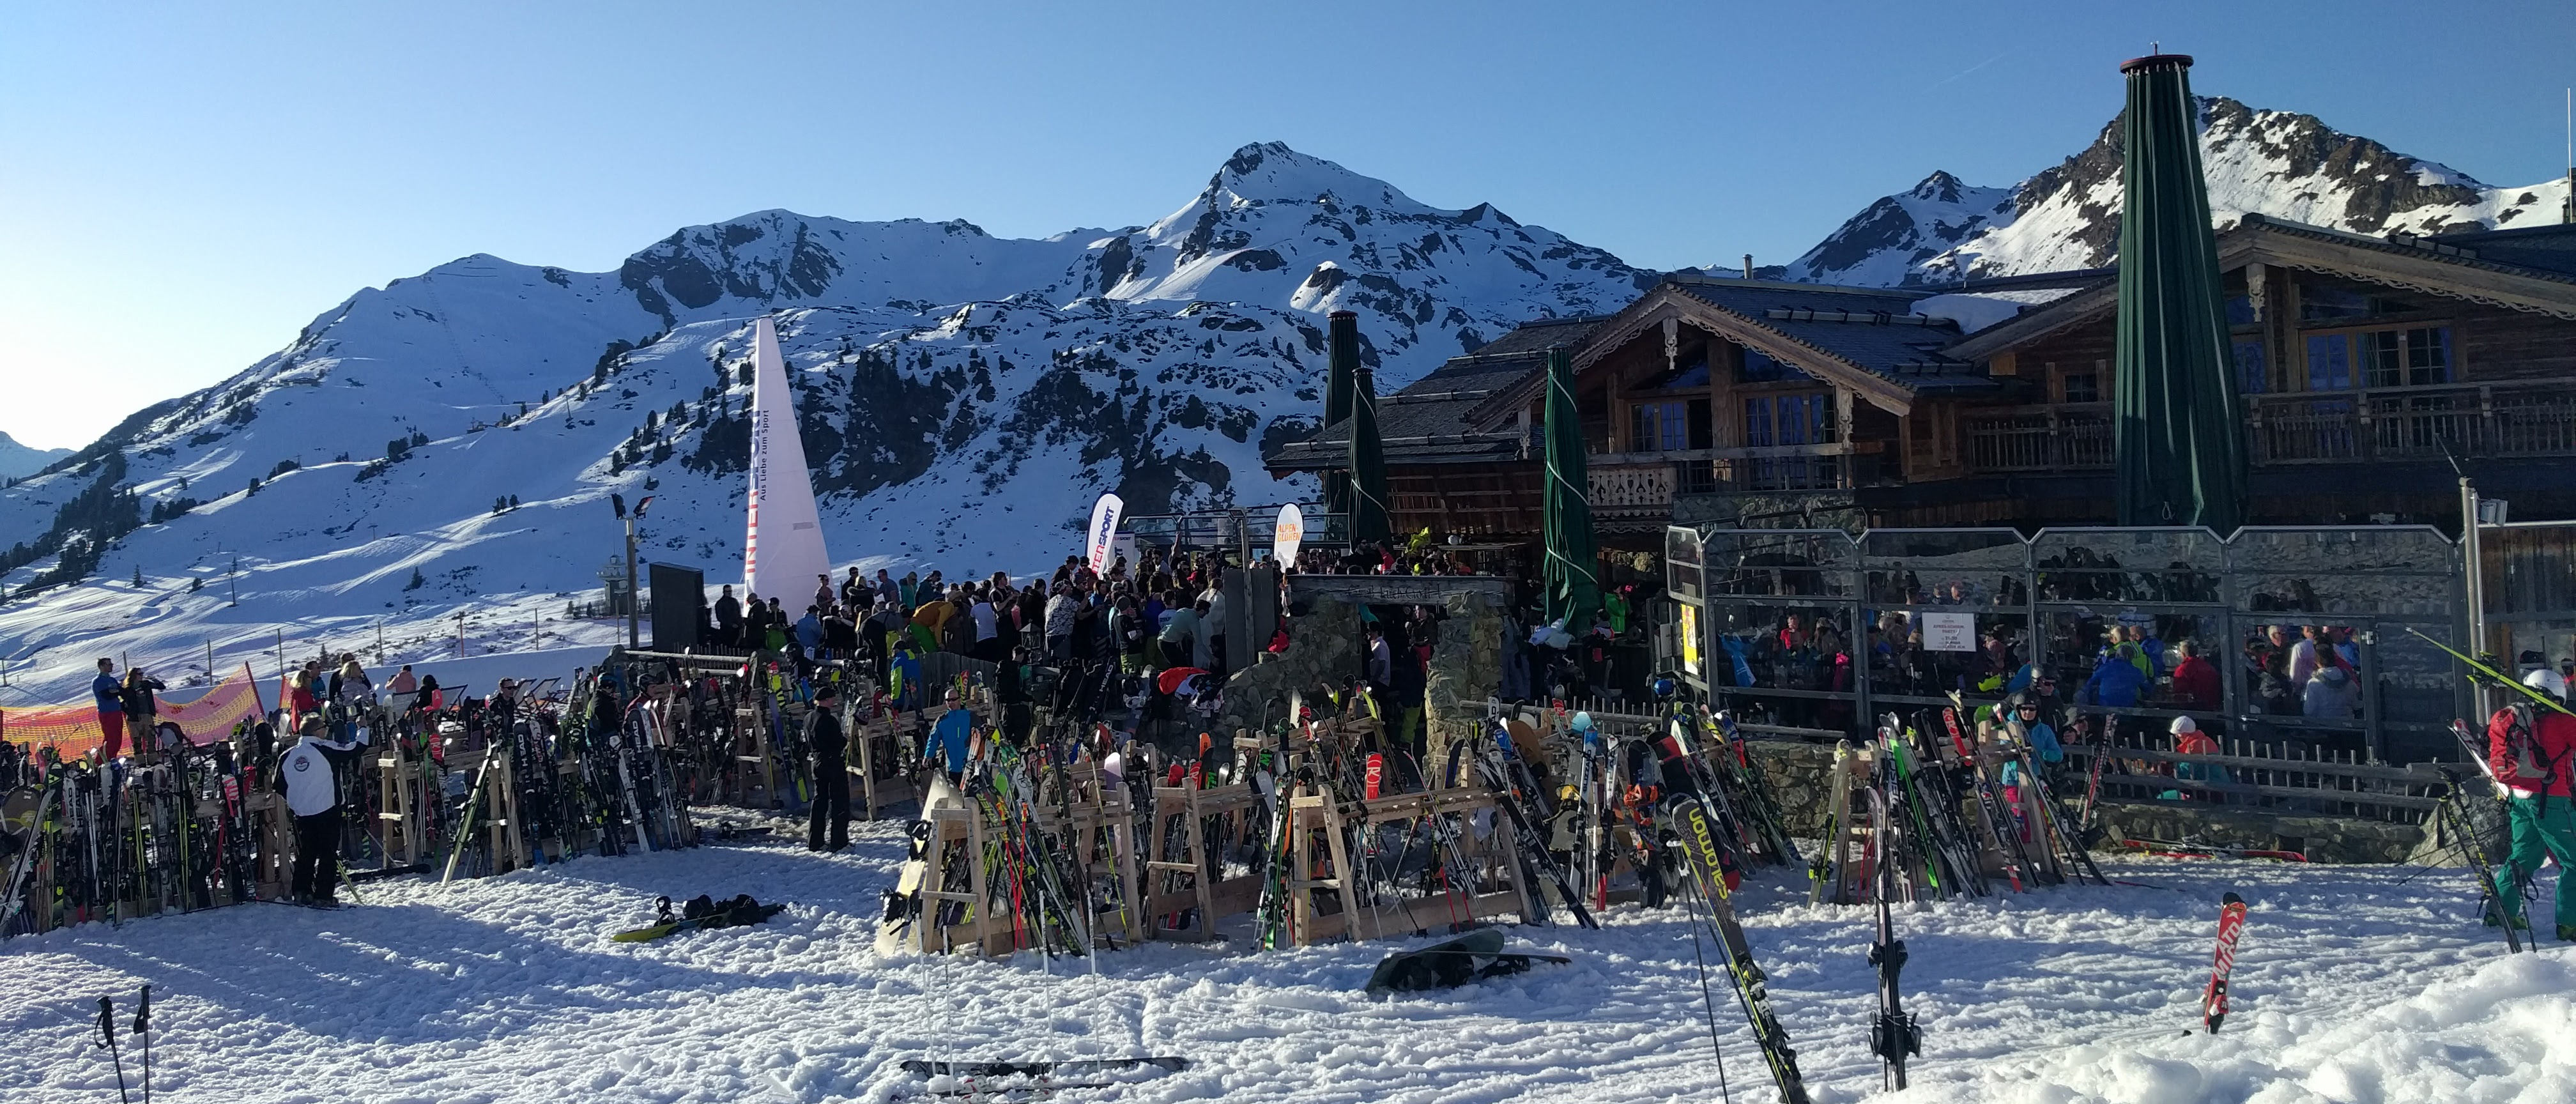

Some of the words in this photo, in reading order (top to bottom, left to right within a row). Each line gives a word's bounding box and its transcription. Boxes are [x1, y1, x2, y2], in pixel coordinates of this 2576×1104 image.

[1099, 664, 1114, 693] HEAD
[518, 734, 528, 767] HEAD
[632, 721, 642, 753] HEAD
[2217, 921, 2241, 955] ATO
